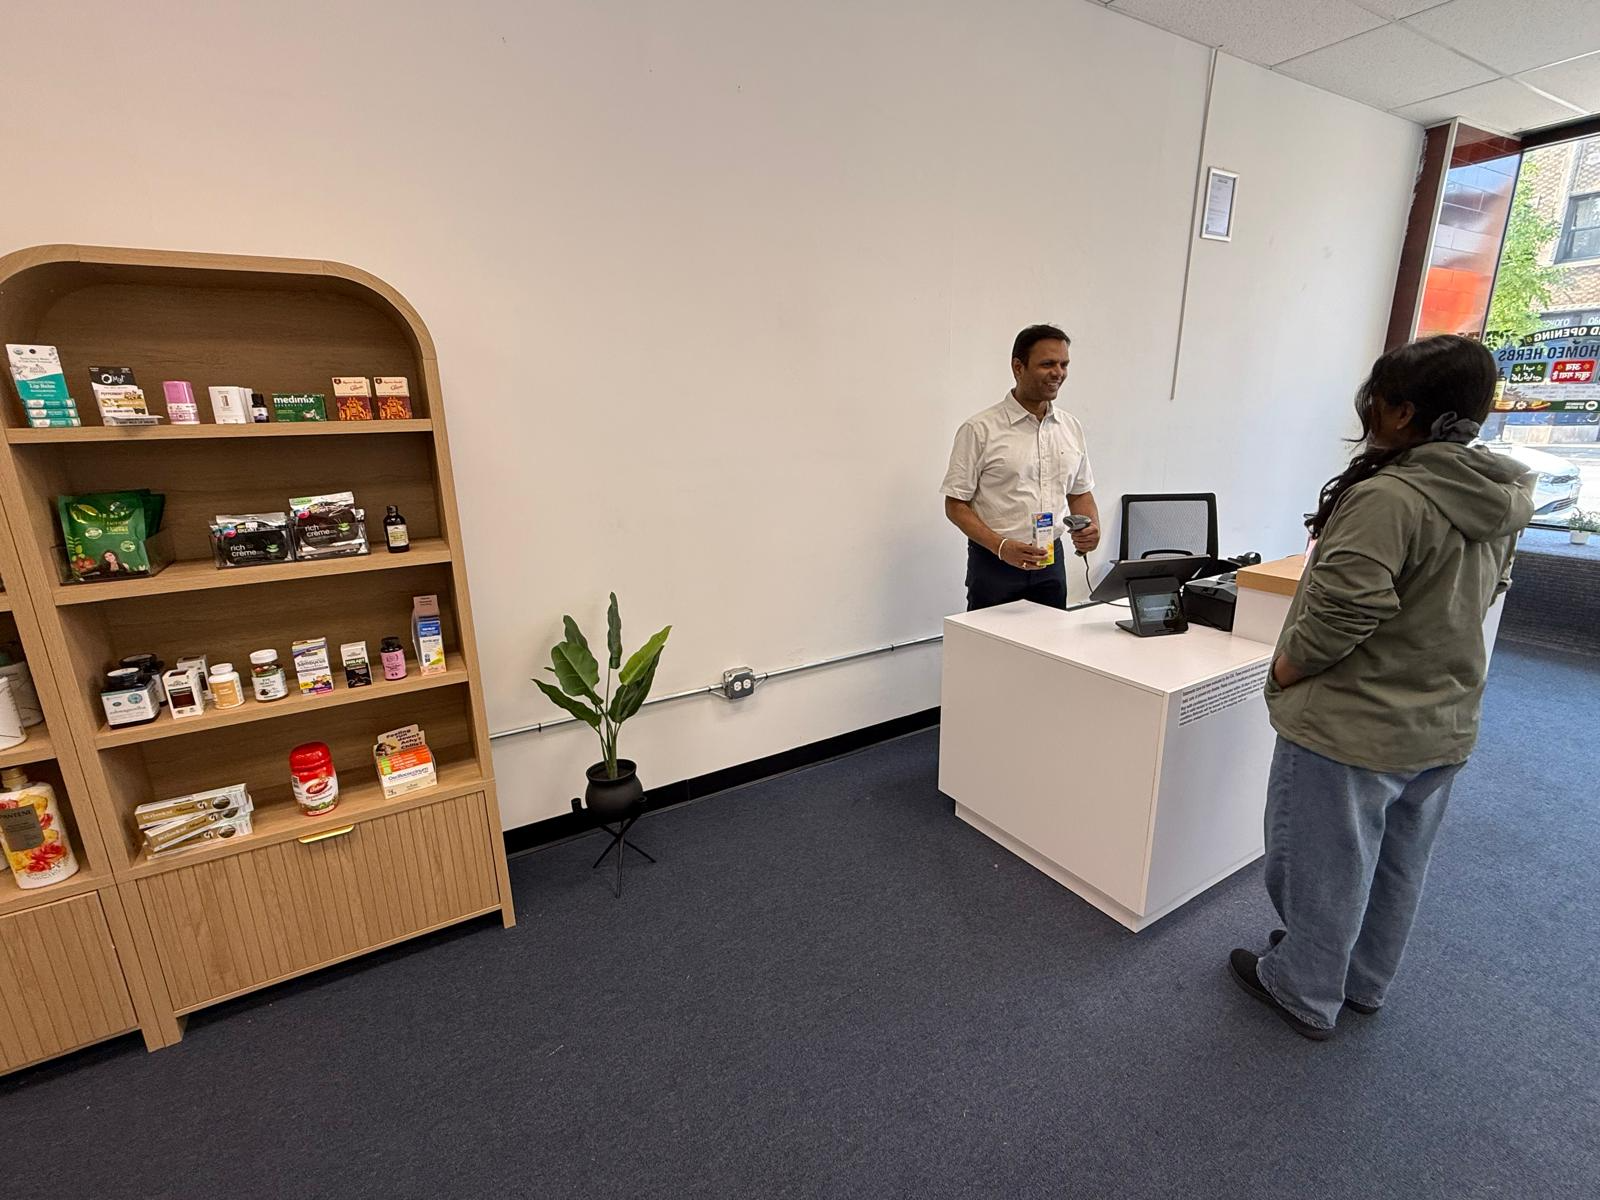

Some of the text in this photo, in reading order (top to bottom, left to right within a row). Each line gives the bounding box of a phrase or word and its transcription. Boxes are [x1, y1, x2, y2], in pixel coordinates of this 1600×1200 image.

[273, 394, 315, 404] medimix
[304, 524, 320, 532] rich
[230, 543, 246, 551] rich
